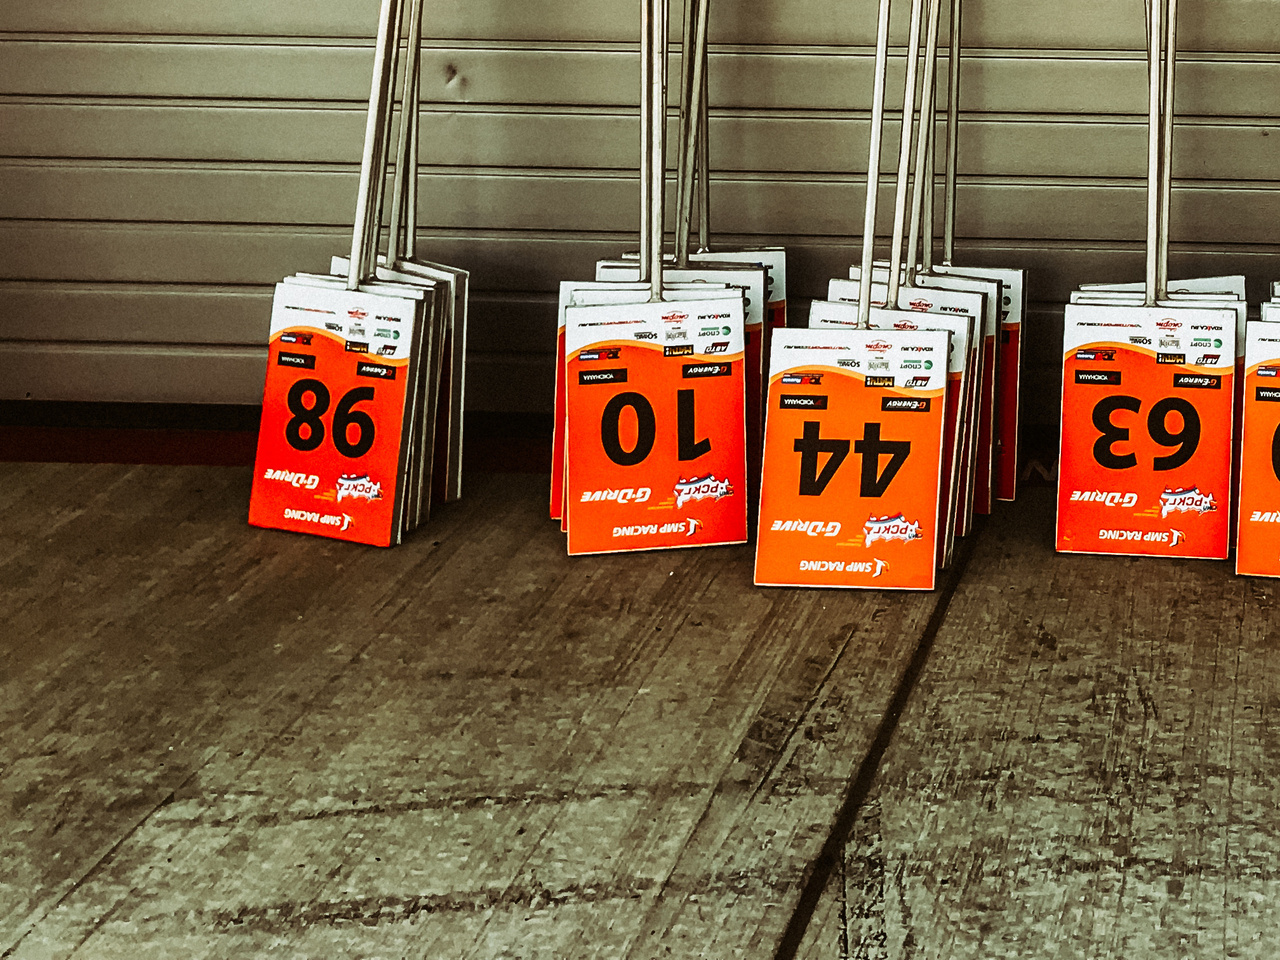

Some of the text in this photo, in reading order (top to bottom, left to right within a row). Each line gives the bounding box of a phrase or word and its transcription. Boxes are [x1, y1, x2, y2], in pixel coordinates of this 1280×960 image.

[286, 379, 374, 458] 98
[602, 390, 711, 465] 10
[1093, 396, 1200, 470] 63
[794, 422, 910, 497] 44
[284, 508, 341, 526] SMP RACING
[612, 522, 685, 536] SMP RACING
[1098, 529, 1168, 541] SMP RACING
[799, 560, 872, 572] SMP RACING
